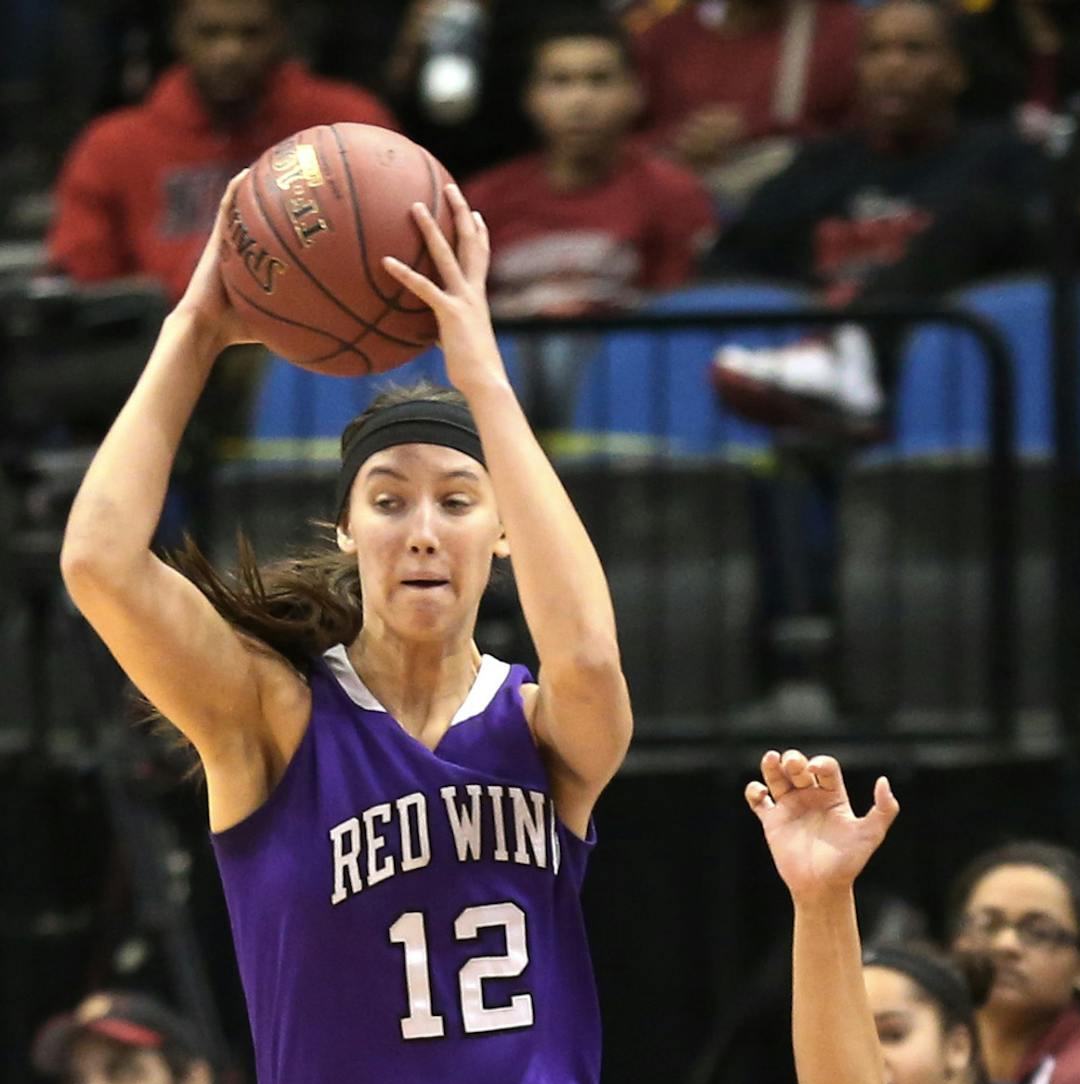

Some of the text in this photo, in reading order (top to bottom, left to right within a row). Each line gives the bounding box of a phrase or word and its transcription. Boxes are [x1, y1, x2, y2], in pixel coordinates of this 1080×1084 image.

[329, 783, 562, 905] RED WIN
[388, 901, 535, 1040] 12
